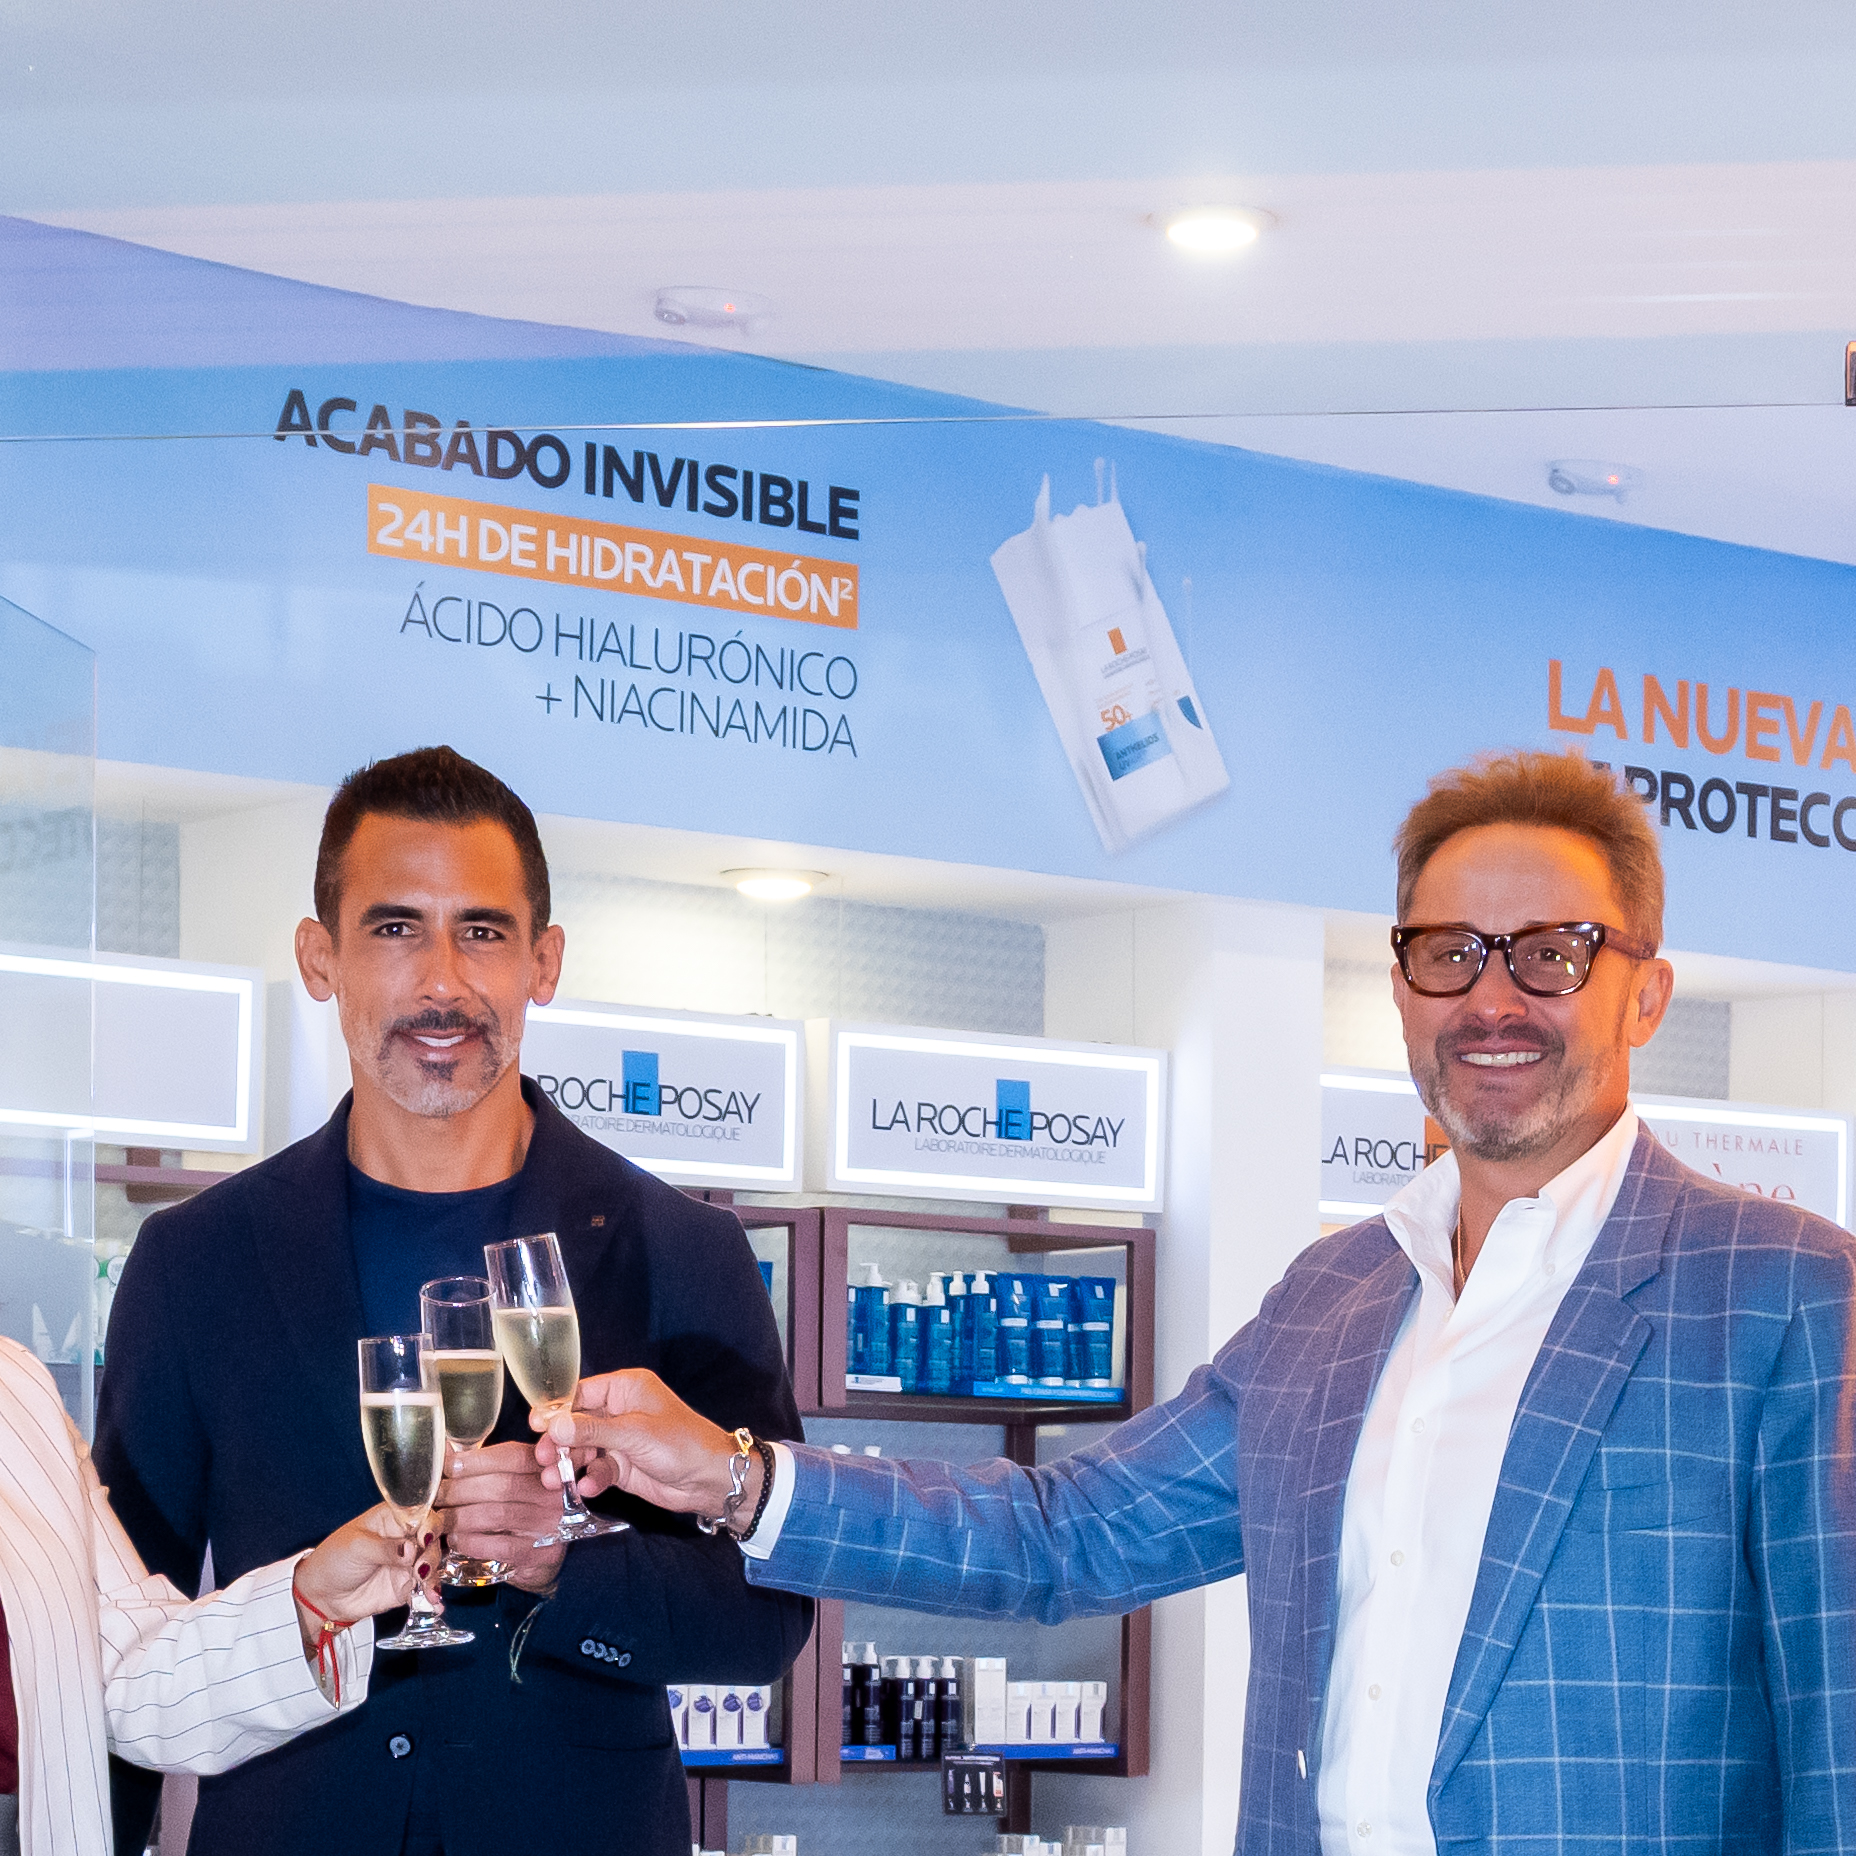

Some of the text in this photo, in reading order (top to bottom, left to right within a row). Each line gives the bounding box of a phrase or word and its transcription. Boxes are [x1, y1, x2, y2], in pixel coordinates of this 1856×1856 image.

[273, 389, 861, 541] ACABADO INVISIBLE
[376, 502, 467, 559] 24H
[478, 520, 536, 569] DE
[400, 581, 858, 700] ÁCIDO HIALURÓNICO
[574, 675, 858, 758] NIACINAMIDA
[1548, 659, 1628, 740] LA
[537, 1075, 761, 1124] ROCHE POSAY
[872, 1099, 1125, 1147] LA ROCHE POSAY
[627, 1120, 742, 1143] DERMATOLOGIQUE
[915, 1137, 1106, 1164] LABORATOIRE DERMATOLOGIQUE
[1694, 1132, 1803, 1156] THERMALE
